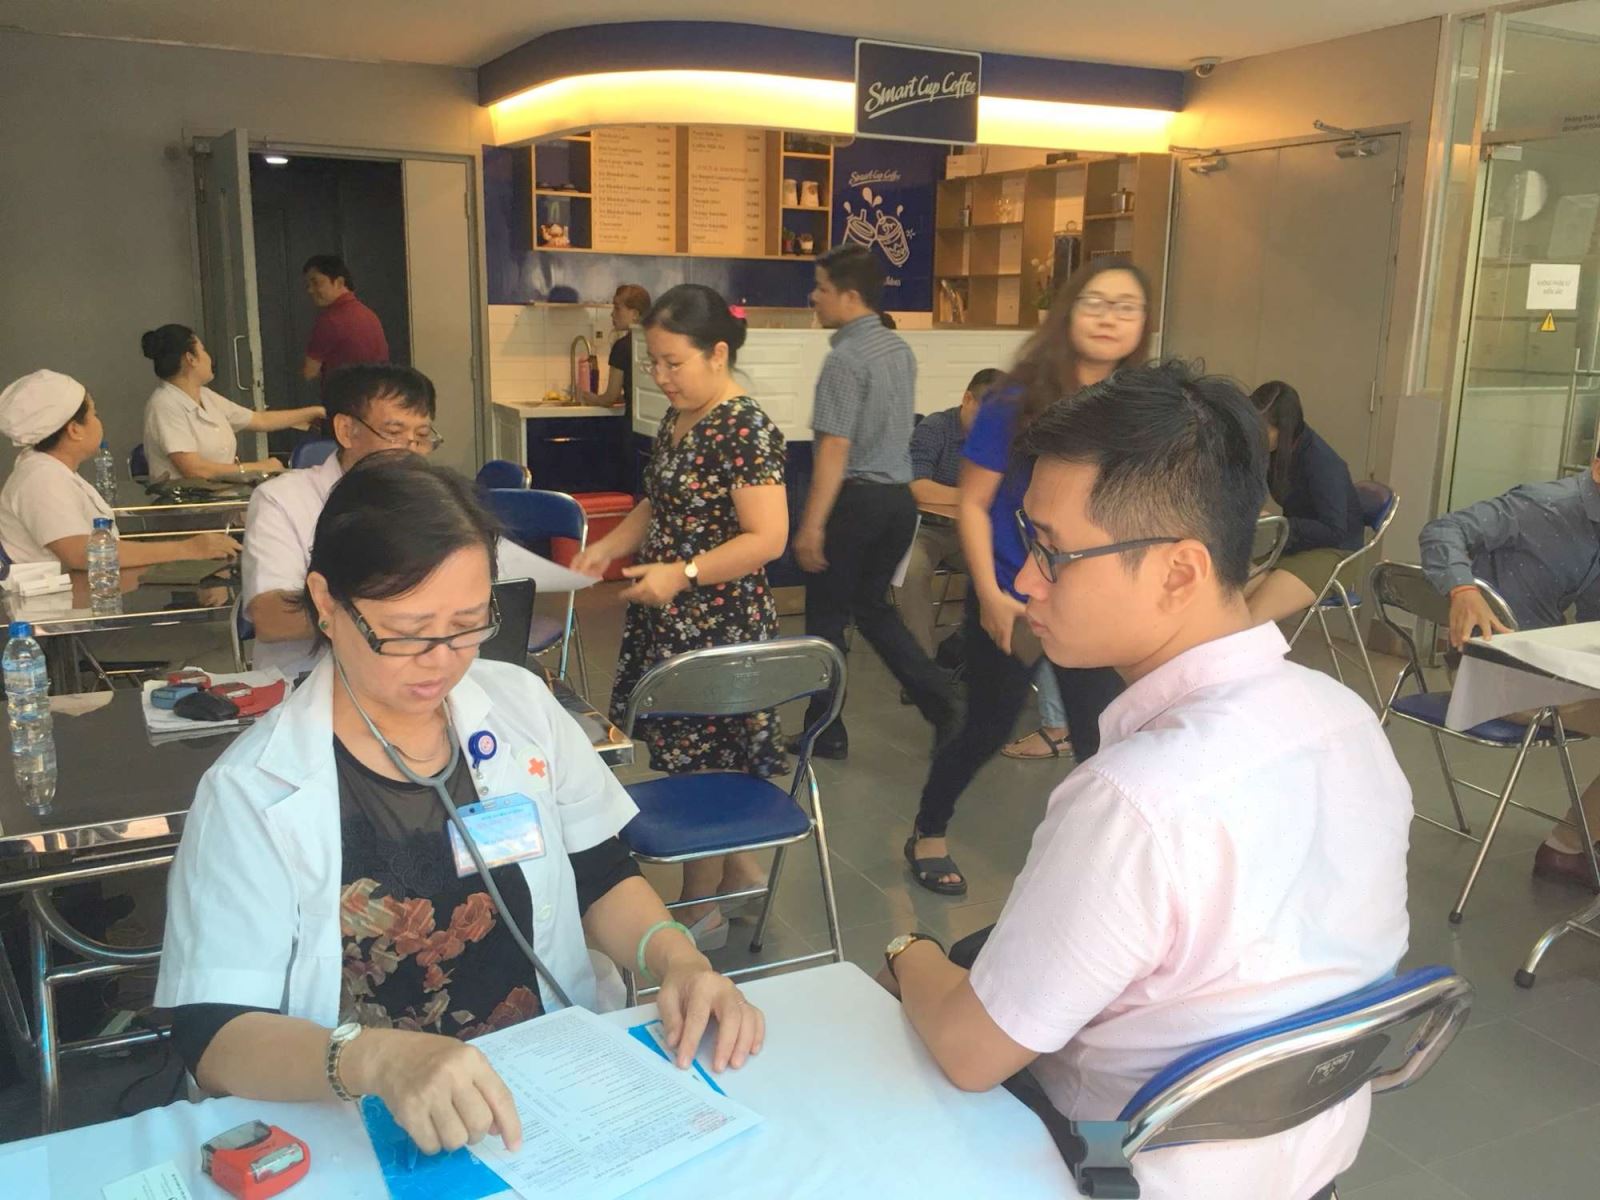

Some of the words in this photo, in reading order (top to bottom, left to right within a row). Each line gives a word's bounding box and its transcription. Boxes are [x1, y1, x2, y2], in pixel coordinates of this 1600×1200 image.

[864, 76, 917, 112] Smart
[917, 75, 940, 102] Cup
[942, 71, 976, 98] Coffee
